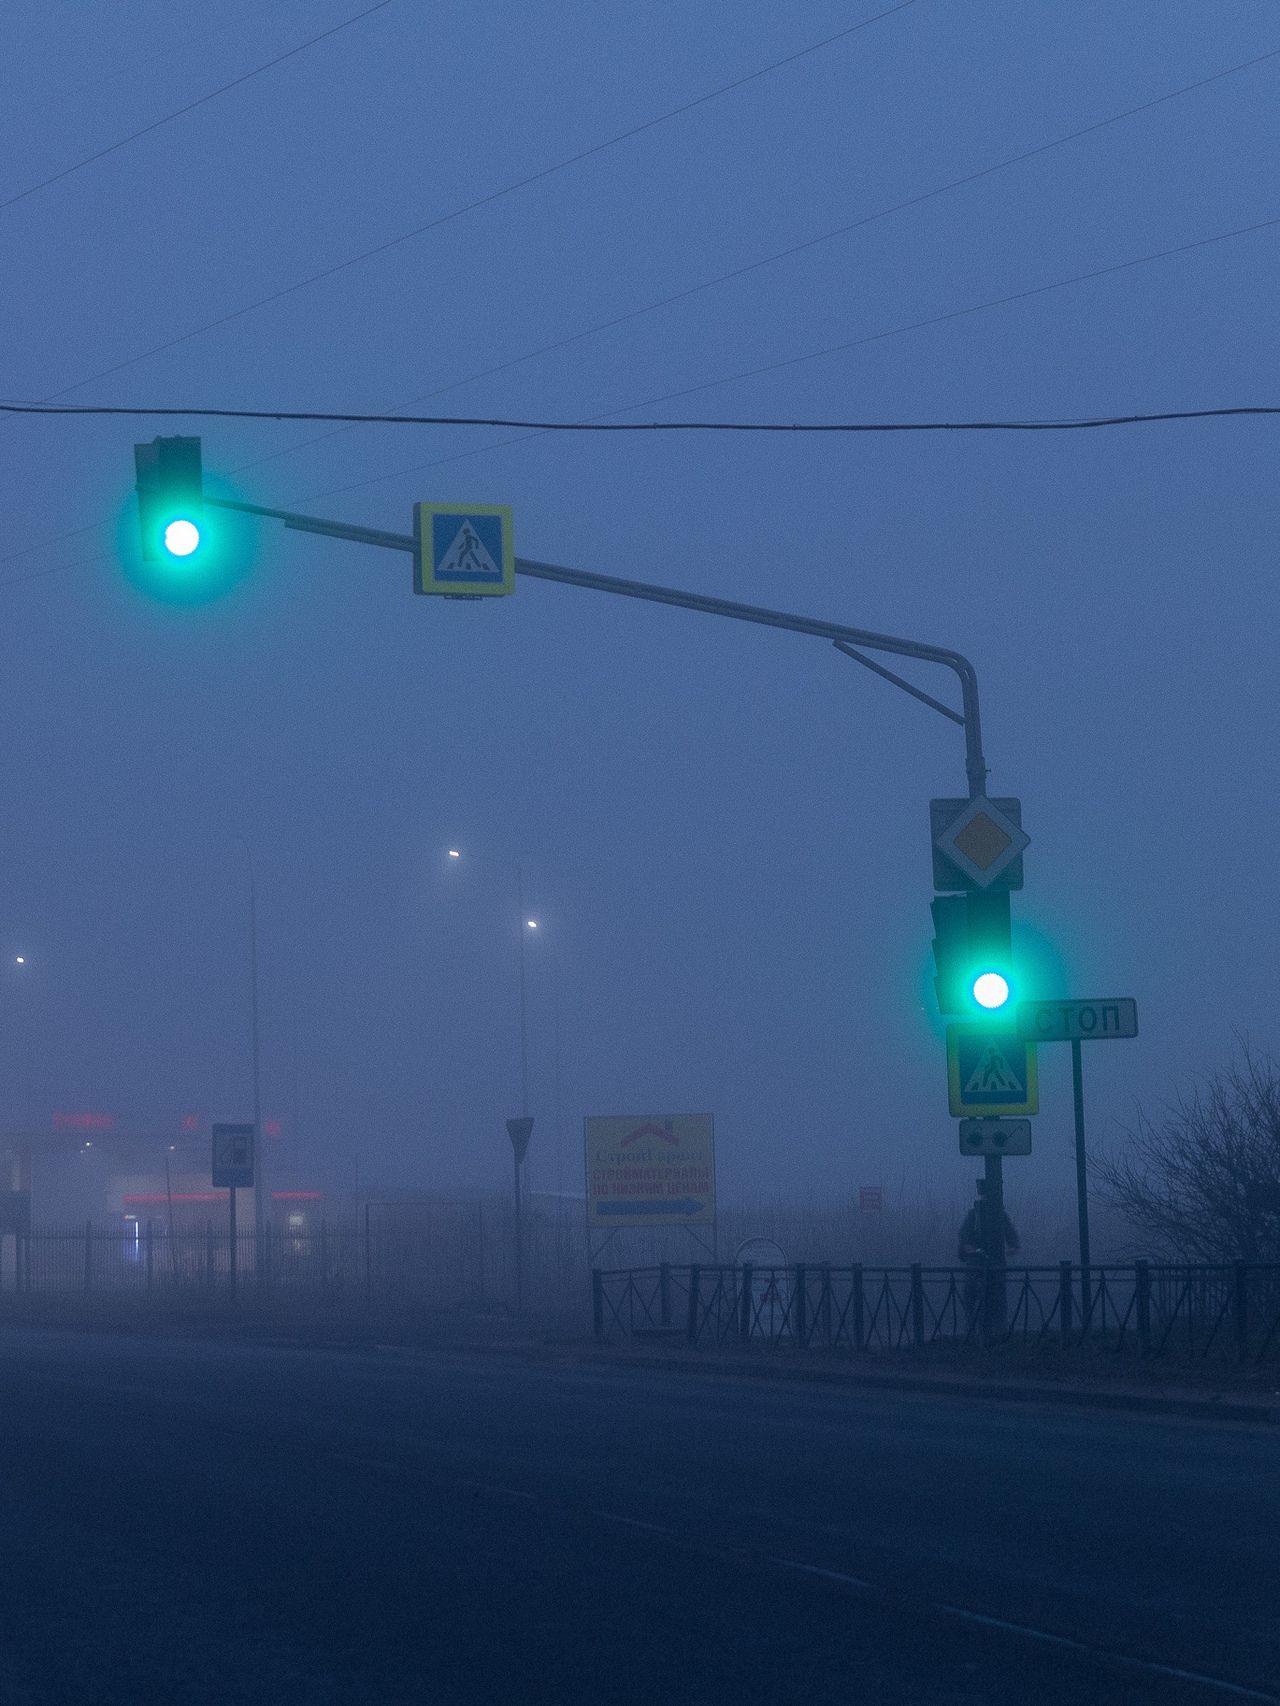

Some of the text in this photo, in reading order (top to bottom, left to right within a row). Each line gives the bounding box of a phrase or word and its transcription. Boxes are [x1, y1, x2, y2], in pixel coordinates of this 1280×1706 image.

[1035, 1005, 1120, 1033] СТОП
[592, 1166, 709, 1180] СТРОЙМАТЕРИАЛЫ
[592, 1181, 710, 1195] ПО НИЗКИМ ЦЕНАМ
